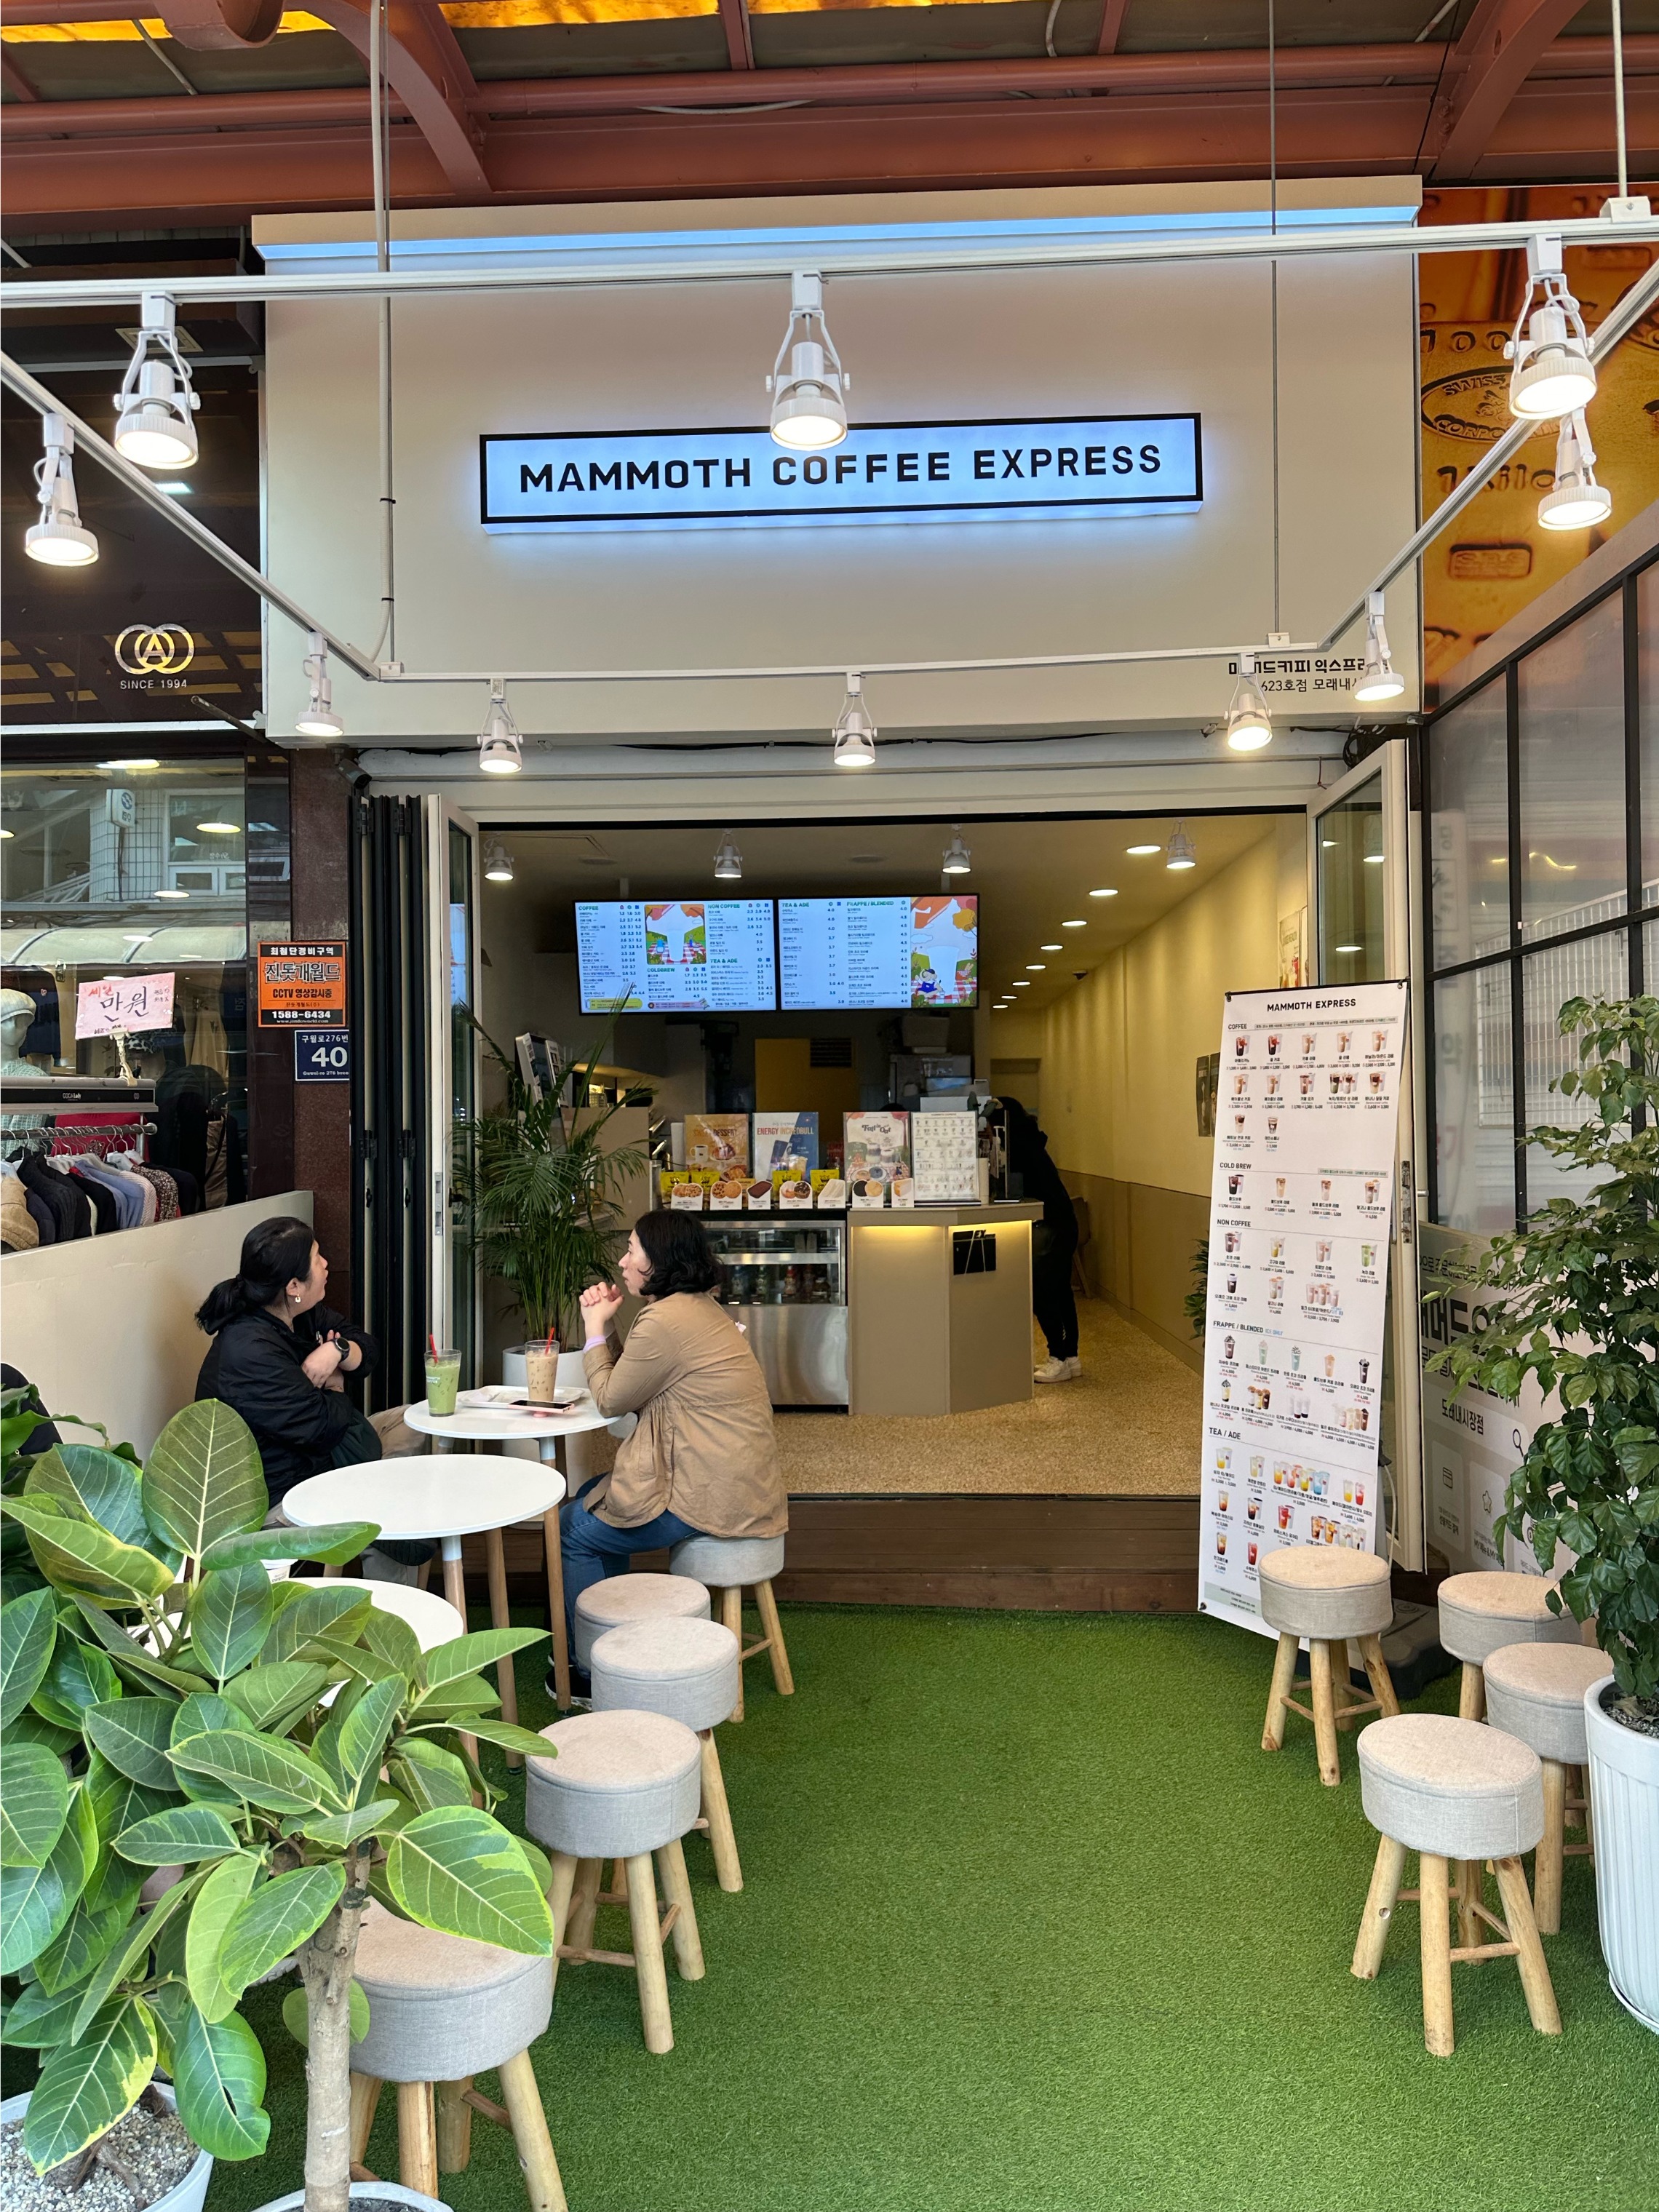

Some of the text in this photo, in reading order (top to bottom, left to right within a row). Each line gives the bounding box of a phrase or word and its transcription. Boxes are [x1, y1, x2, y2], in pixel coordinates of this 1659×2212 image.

[1442, 374, 1506, 396] SWISS
[520, 444, 1161, 494] MAMMOTH COFFEE EXPRESS
[1314, 659, 1368, 673] 익스프
[120, 679, 188, 690] SINCE 1994
[270, 947, 335, 956] 최첨단경비구역
[265, 961, 341, 983] 진돗개월드
[273, 989, 333, 998] CCTV 영상감시중
[1267, 998, 1356, 1012] MAMMOTH EXPRESS
[272, 1011, 331, 1019] 1588-6434
[301, 1034, 349, 1043] 구월로276번
[311, 1046, 348, 1067] 40
[757, 1127, 779, 1135] ENERGY
[1213, 1321, 1235, 1329] FRAPPE
[1240, 1324, 1264, 1333] BLENDED
[1209, 1427, 1222, 1436] TEA
[1228, 1431, 1241, 1440] ADE
